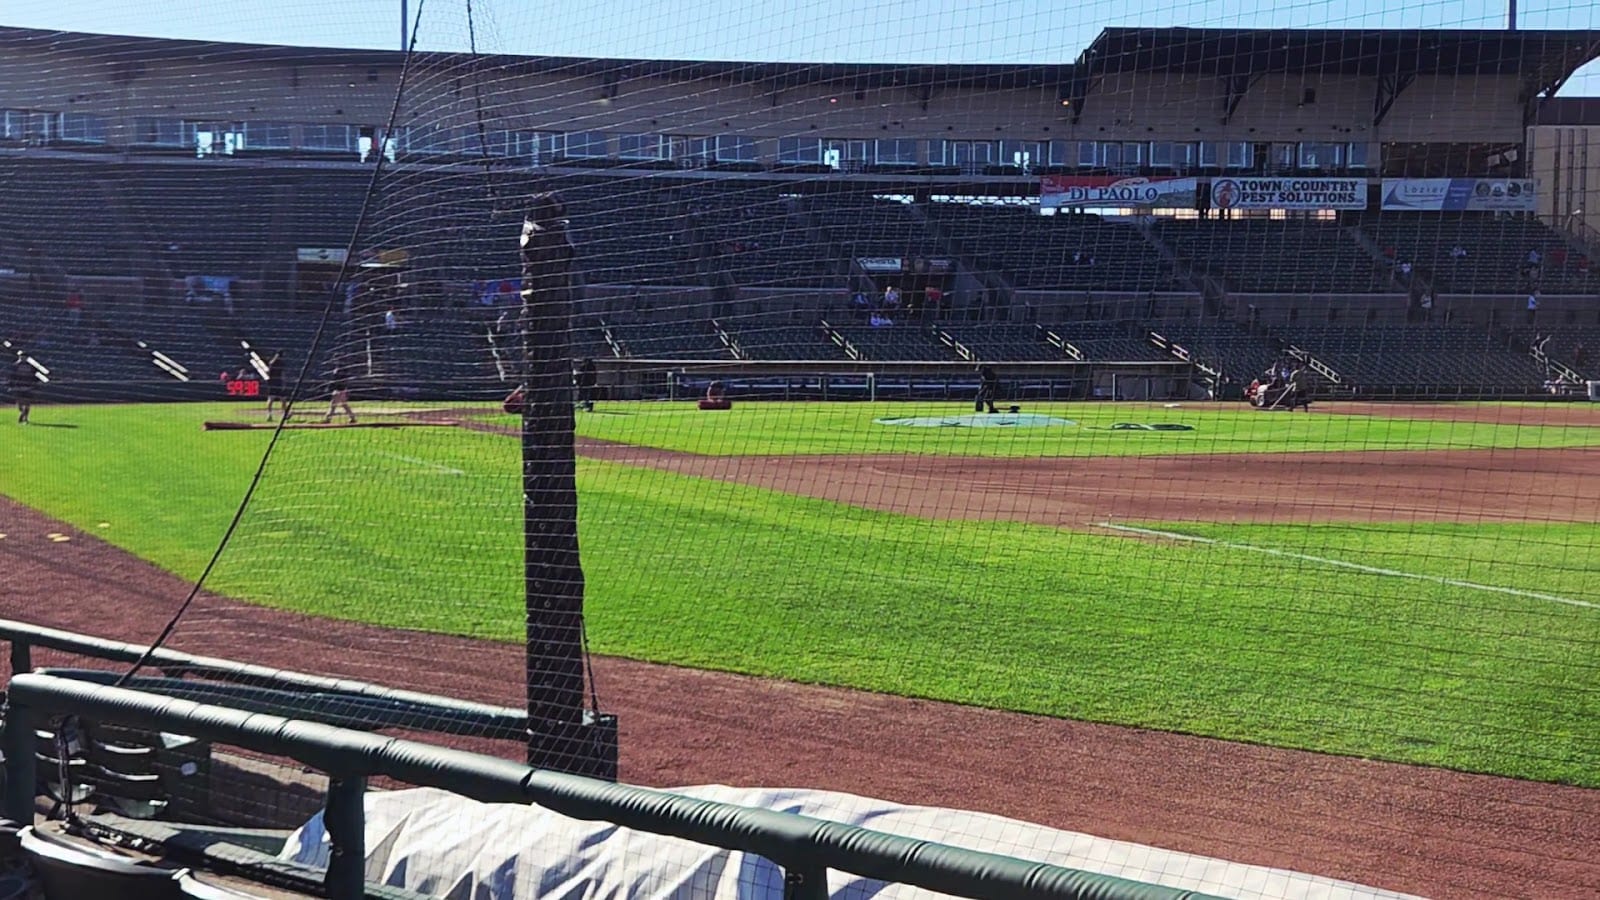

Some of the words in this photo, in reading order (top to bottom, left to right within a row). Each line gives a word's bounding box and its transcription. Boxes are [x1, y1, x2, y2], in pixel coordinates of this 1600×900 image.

[1071, 187, 1090, 201] DI
[1098, 187, 1158, 201] PAOLO
[1241, 192, 1275, 203] PEST
[1278, 192, 1355, 203] SOLUTIONS
